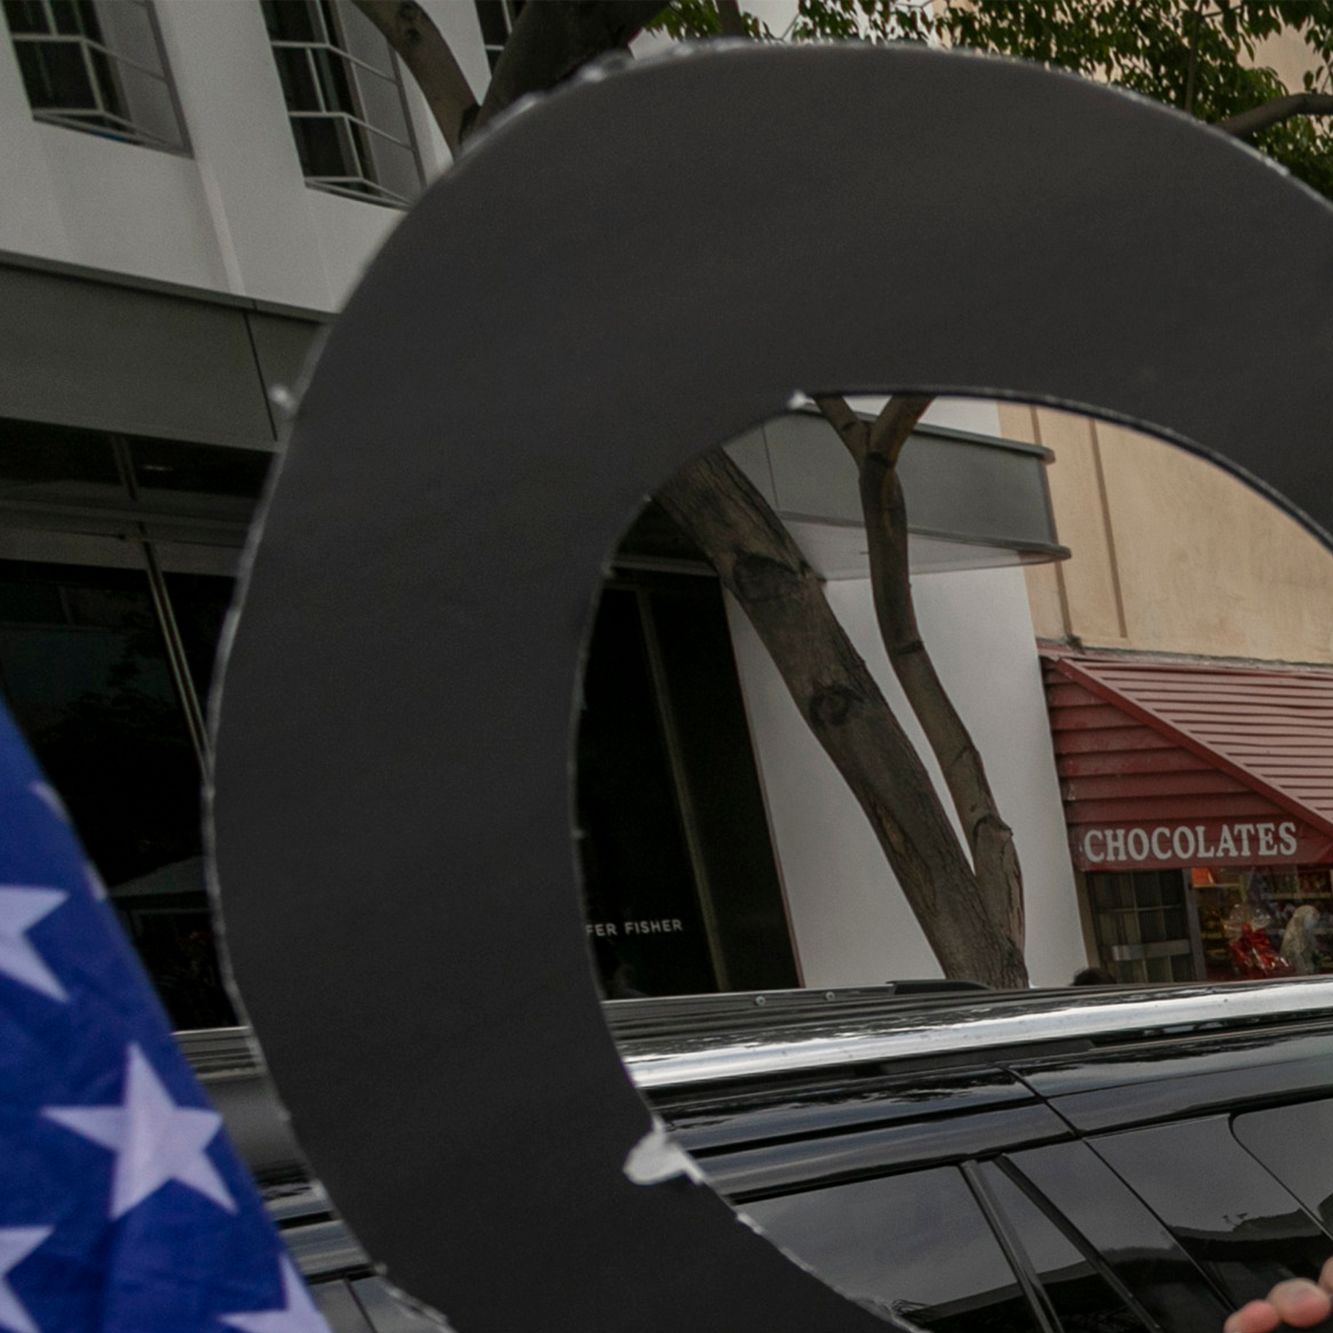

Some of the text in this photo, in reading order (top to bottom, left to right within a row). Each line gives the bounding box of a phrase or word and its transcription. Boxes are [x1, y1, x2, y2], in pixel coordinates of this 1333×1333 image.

[1083, 822, 1299, 863] CHOCOLATES
[585, 918, 683, 937] FER FISHER
